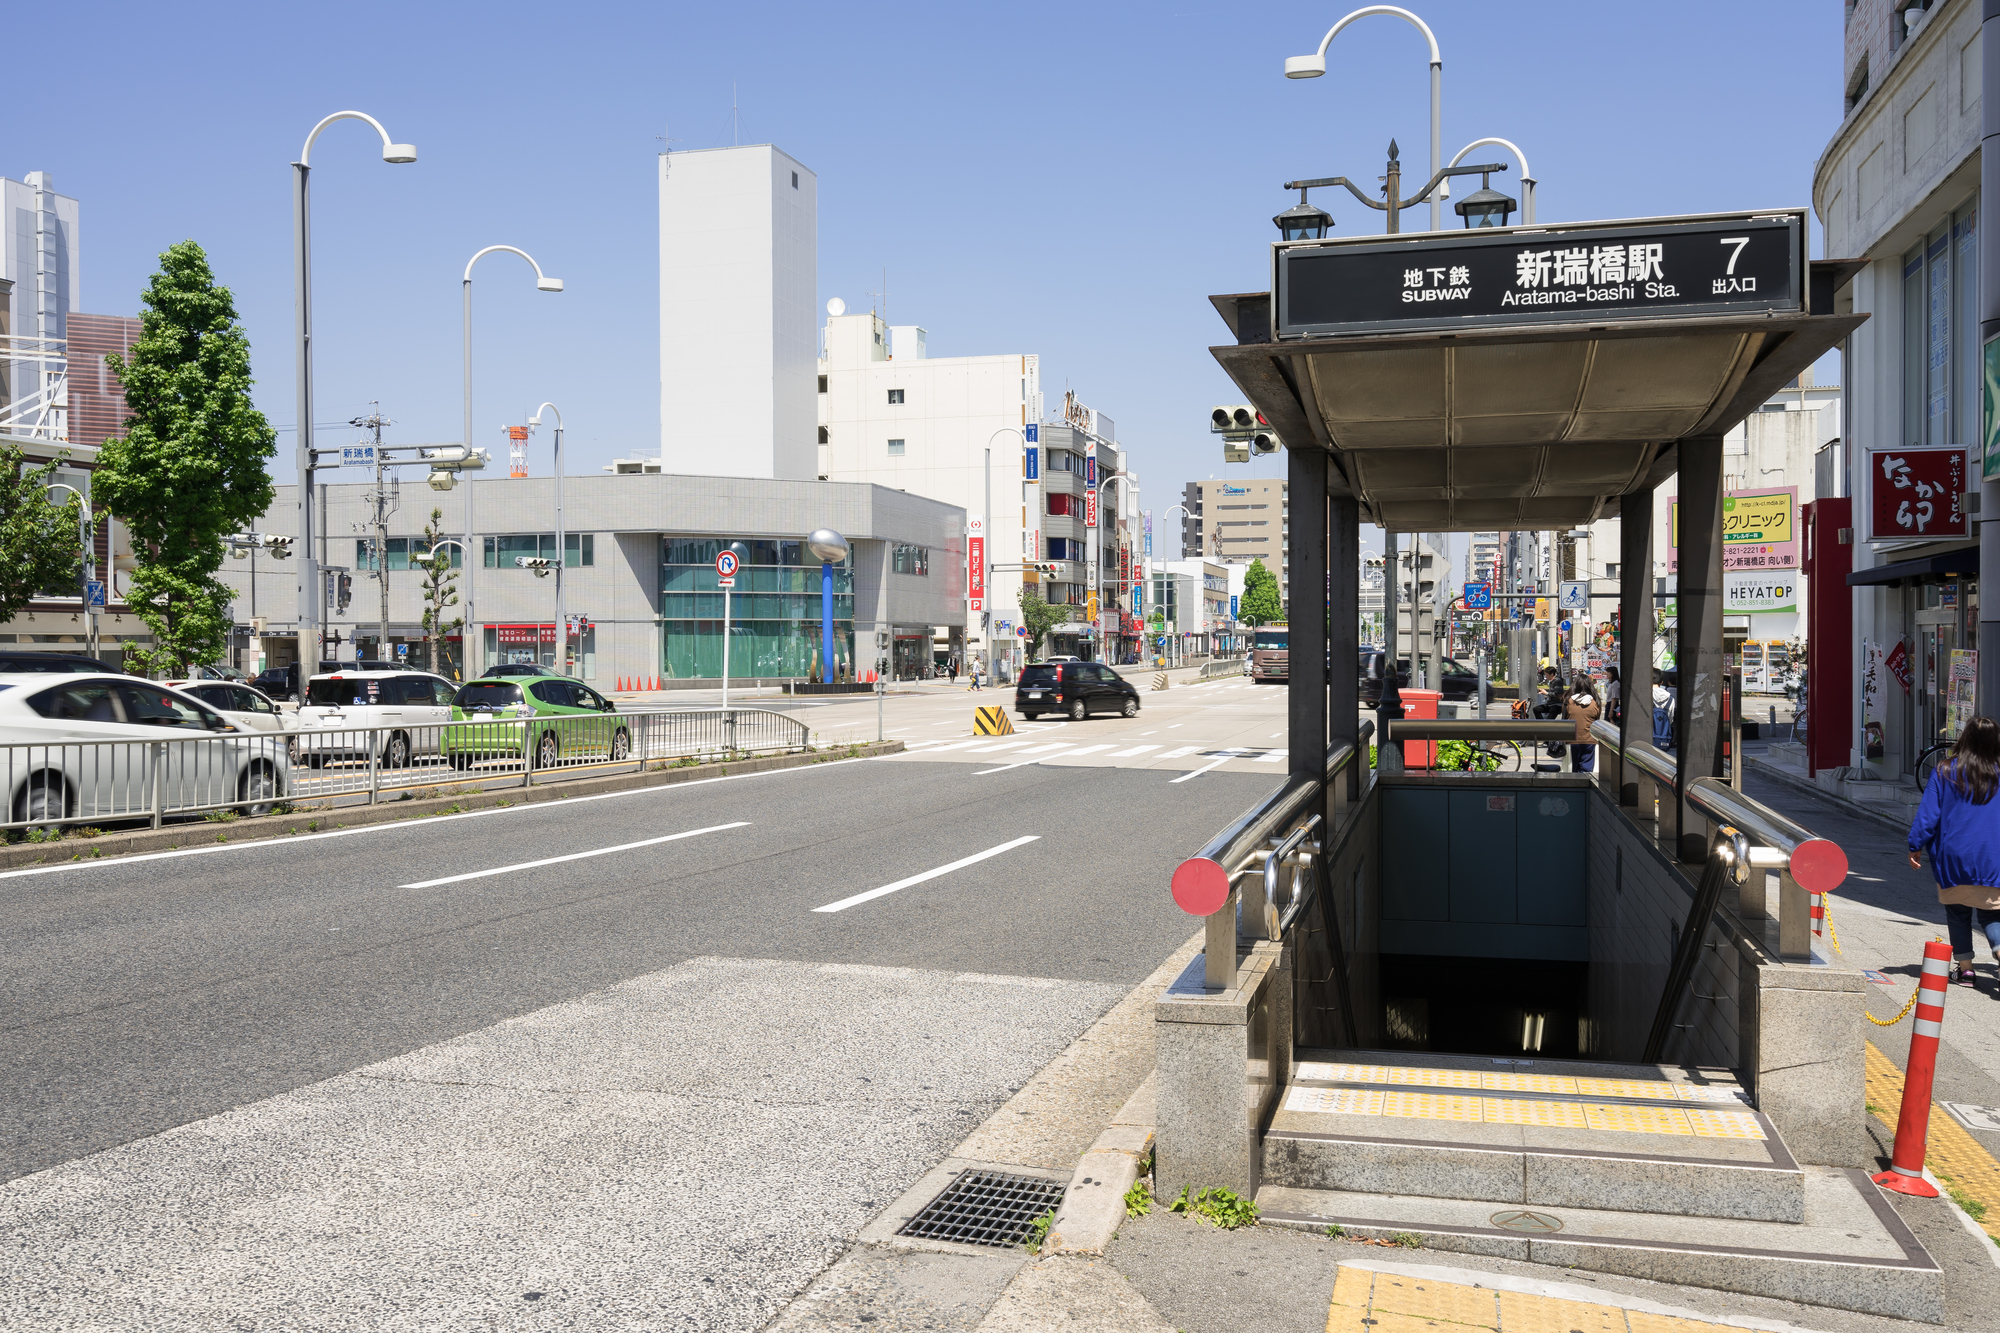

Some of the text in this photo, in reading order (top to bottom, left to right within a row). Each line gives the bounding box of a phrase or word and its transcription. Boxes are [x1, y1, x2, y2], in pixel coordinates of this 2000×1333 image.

[1516, 243, 1664, 289] 新瑞橋駅
[1720, 237, 1750, 275] 7
[1403, 265, 1470, 288] 地下鉄
[1712, 277, 1757, 295] 出入口
[1402, 287, 1472, 303] SUBWAY
[1501, 281, 1680, 307] Aratama-bashi Sta.
[343, 447, 374, 458] 新瑞橋
[1881, 454, 1946, 533] なか卯
[1730, 586, 1792, 599] HEYATOP
[973, 601, 979, 609] P
